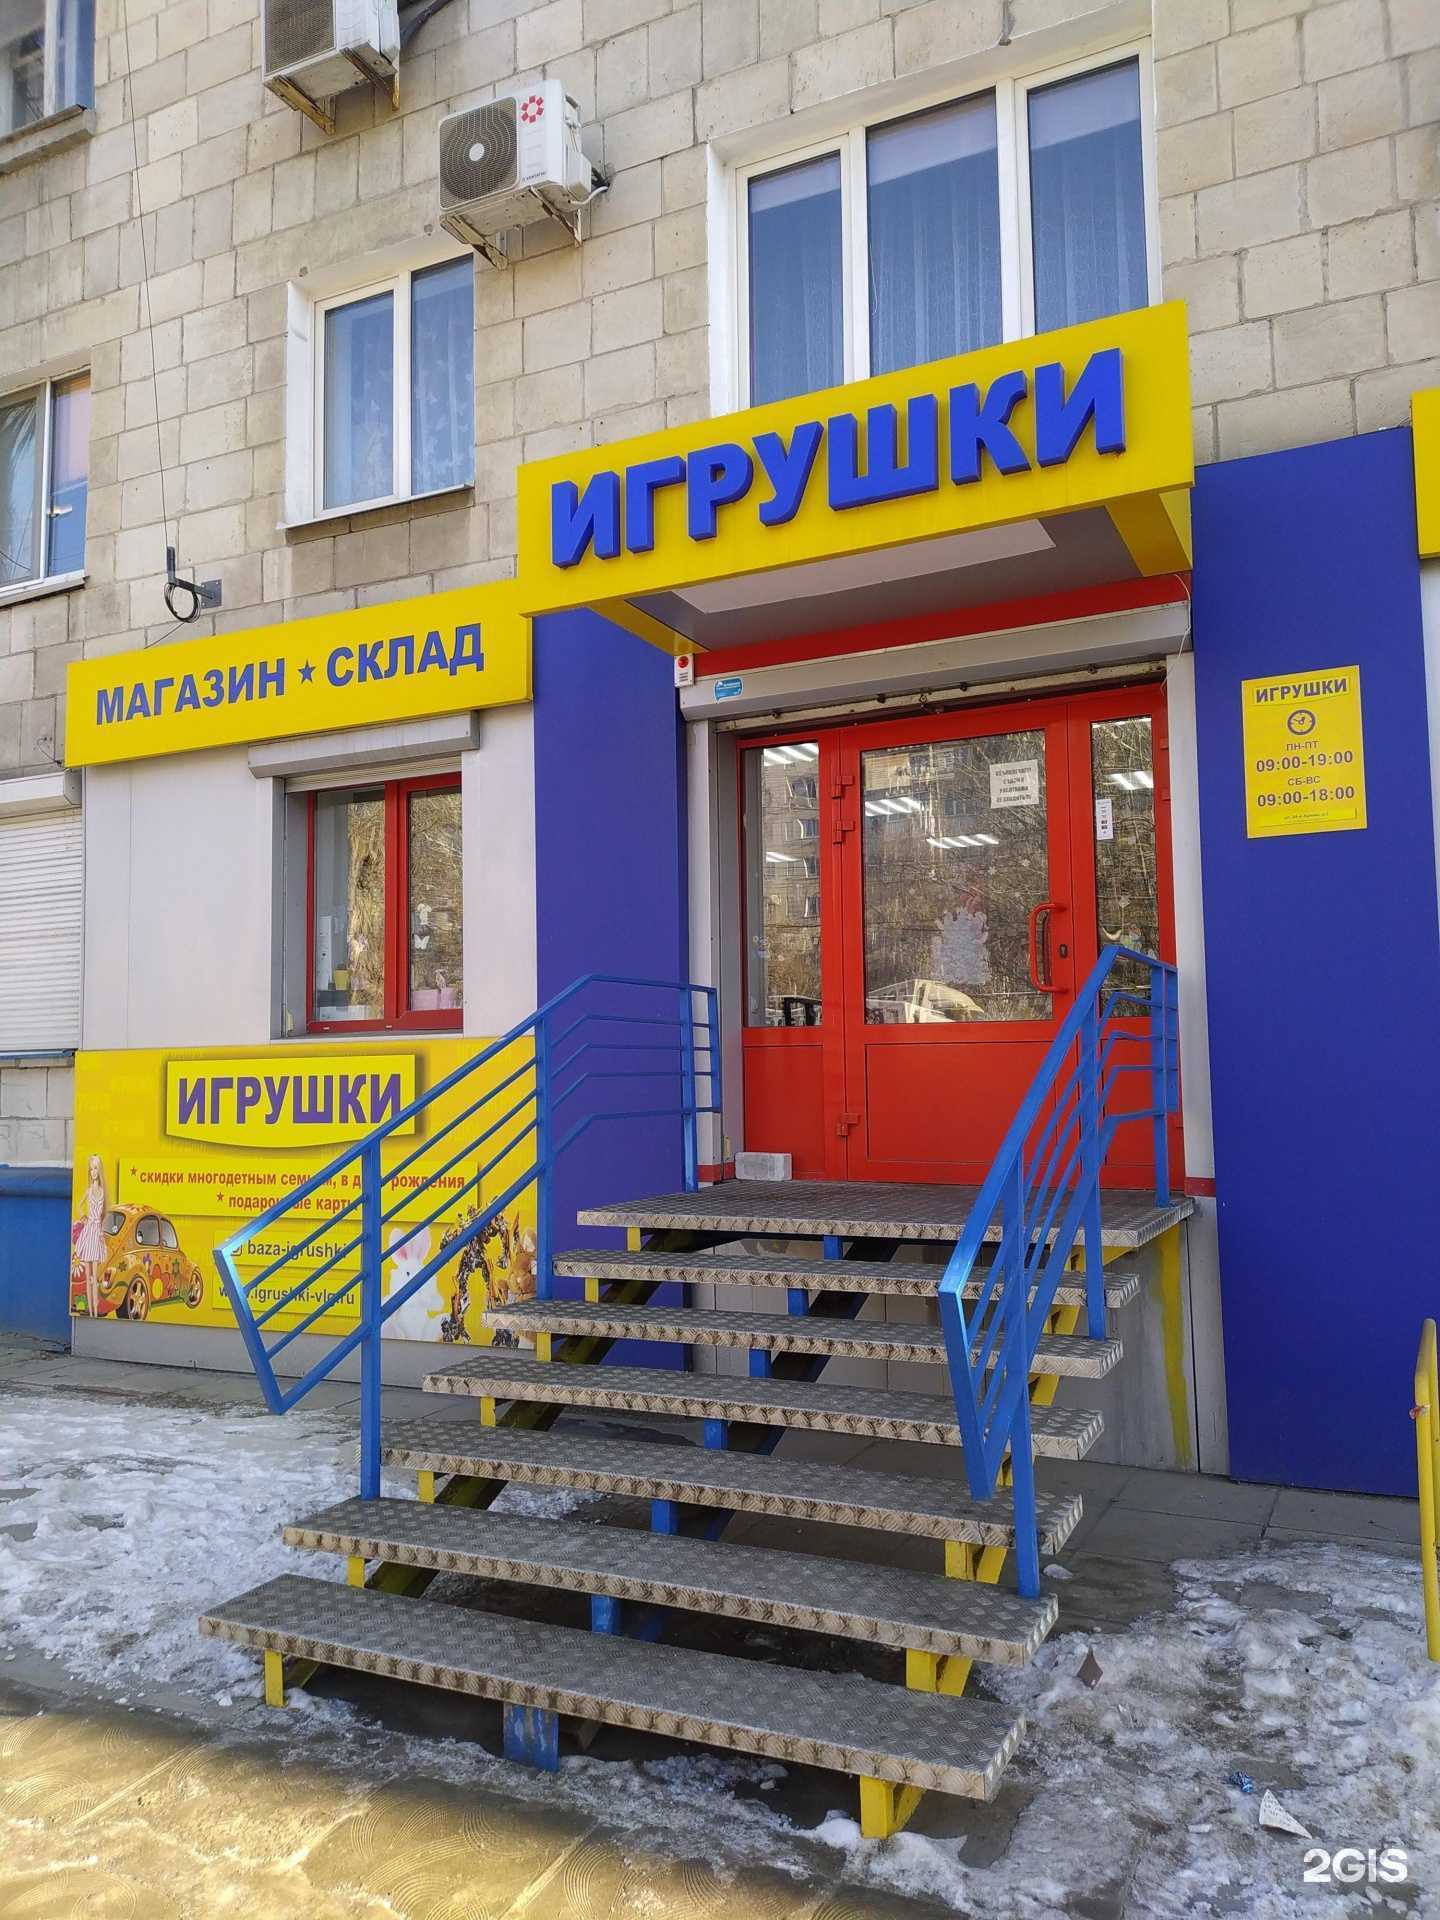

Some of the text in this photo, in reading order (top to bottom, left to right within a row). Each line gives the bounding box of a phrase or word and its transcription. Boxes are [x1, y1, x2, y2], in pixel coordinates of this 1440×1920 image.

[551, 347, 1127, 569] ИГРУШКИ
[95, 622, 485, 726] МАГАЗИН СКЛАД
[1255, 678, 1348, 704] ИГРУШКИ
[1286, 740, 1320, 752] ПН-ПТ
[1256, 750, 1354, 773] 09:00-19:00
[1287, 775, 1321, 787] СБ-ВС
[1257, 786, 1355, 807] 09:00-18:00
[178, 1073, 401, 1125] ИГРУШКИ
[139, 1171, 184, 1185] скидки
[187, 1172, 277, 1187] многодетным
[280, 1174, 337, 1190] сем,
[228, 1196, 312, 1212] подароые
[218, 1286, 355, 1305] w.igruski-vl.ru
